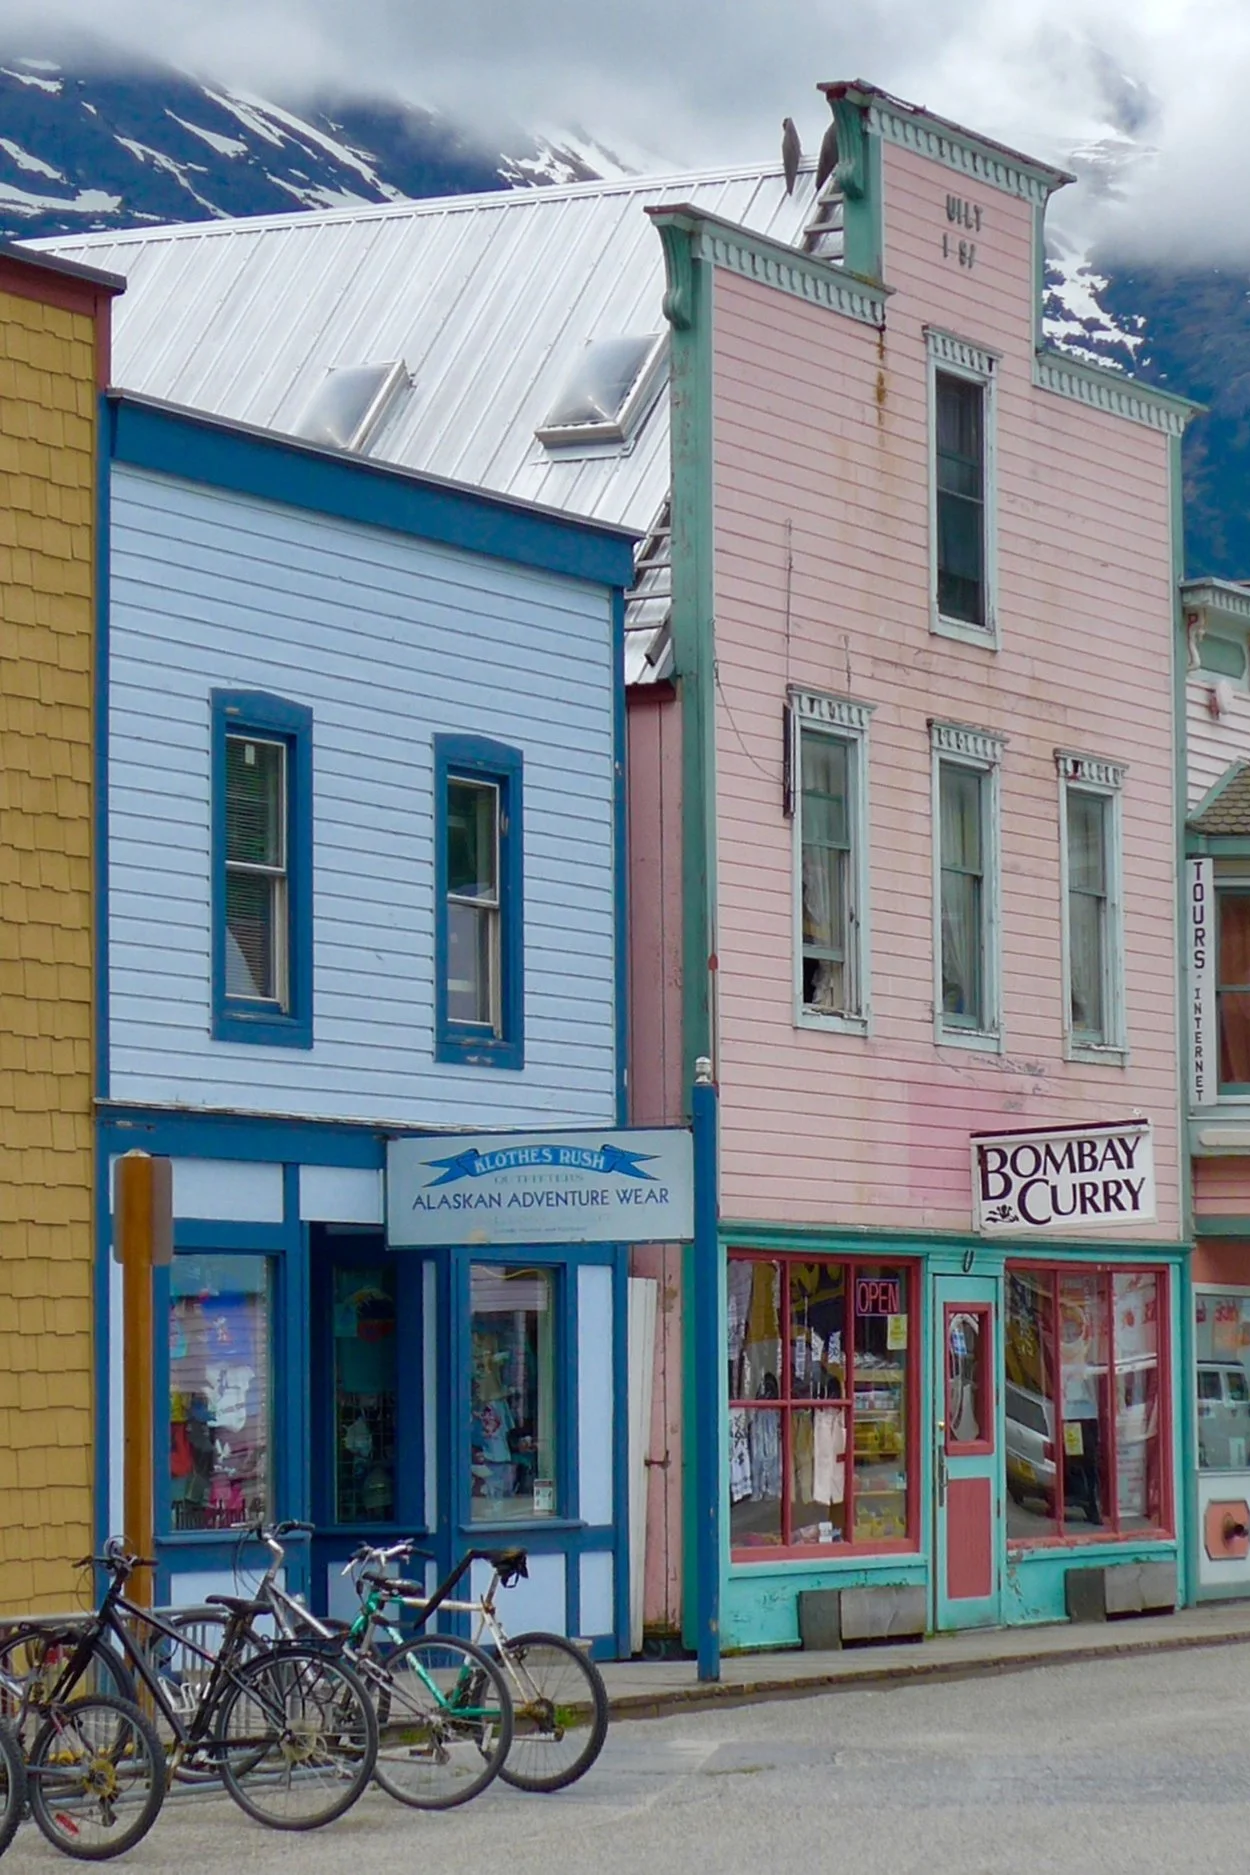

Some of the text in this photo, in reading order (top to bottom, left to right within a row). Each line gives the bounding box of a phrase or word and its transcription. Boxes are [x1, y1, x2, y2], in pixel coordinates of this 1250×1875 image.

[1192, 861, 1206, 970] TOURS
[1194, 987, 1204, 1102] INTERNET
[474, 1147, 605, 1174] KLOTHES RUSH
[979, 1136, 1142, 1201] BOMBAY
[411, 1188, 670, 1211] ALASKAN ADVENTURE WEAR
[1017, 1177, 1146, 1226] CURRY
[859, 1282, 899, 1313] OPEN
